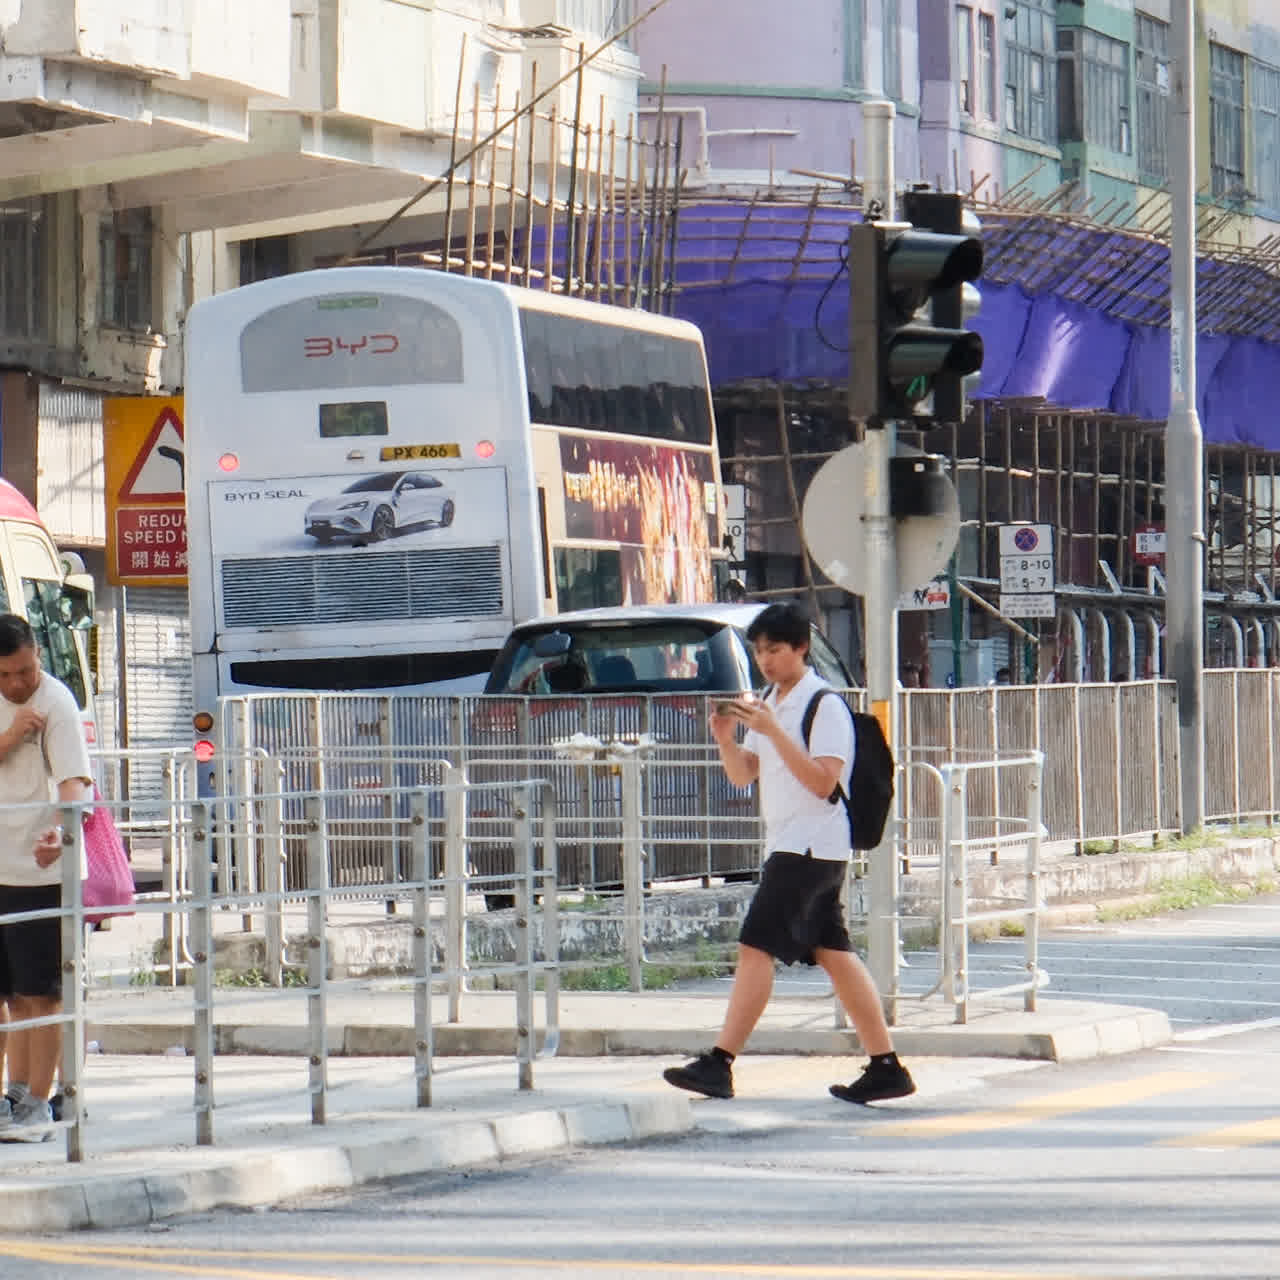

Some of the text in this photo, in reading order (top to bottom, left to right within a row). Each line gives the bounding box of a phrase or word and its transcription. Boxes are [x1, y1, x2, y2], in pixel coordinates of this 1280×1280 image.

[304, 334, 400, 358] BYD
[393, 443, 448, 459] PX 466
[224, 487, 309, 502] BYD SEAL
[138, 514, 187, 528] REDU
[124, 530, 176, 544] SPEED
[1021, 560, 1050, 570] 8-10
